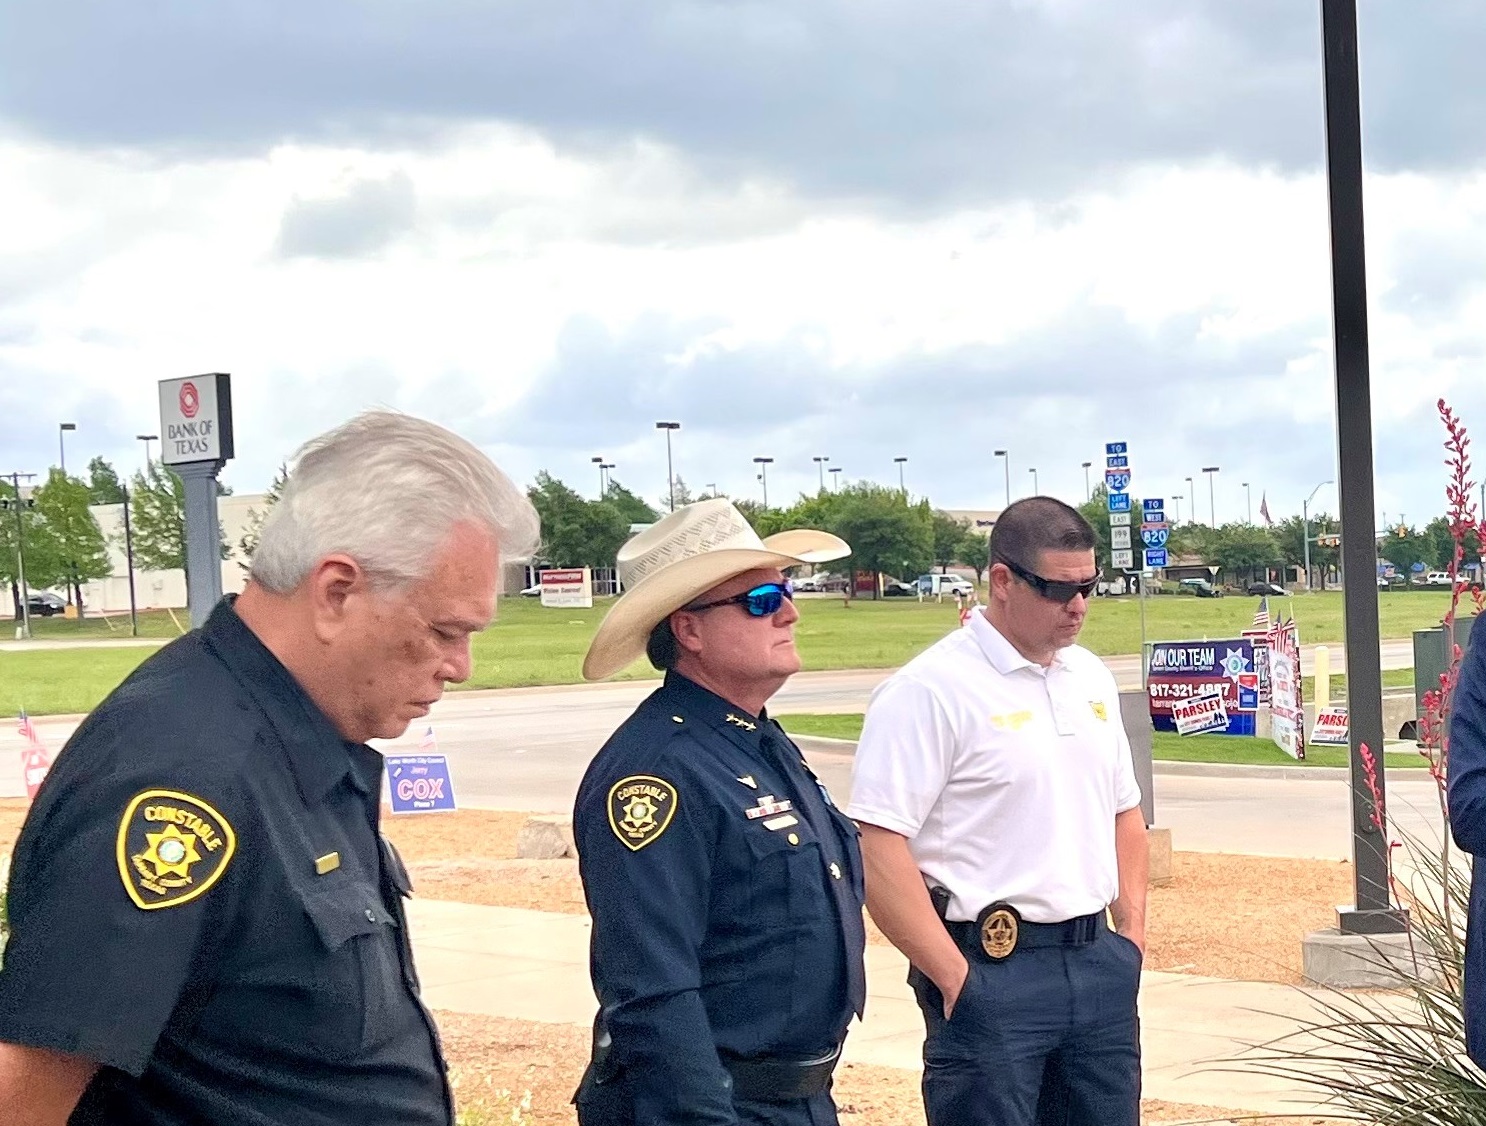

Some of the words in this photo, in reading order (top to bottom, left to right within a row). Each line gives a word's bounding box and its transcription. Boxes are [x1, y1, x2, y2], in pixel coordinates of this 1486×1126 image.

[168, 421, 198, 439] BANK
[200, 420, 213, 436] OF
[174, 438, 208, 455] TEXAS
[1111, 445, 1122, 453] TO
[1109, 457, 1126, 466] EAST
[1107, 474, 1129, 488] 820
[1111, 494, 1127, 502] LEFT
[1111, 501, 1127, 509] LANE
[1113, 515, 1127, 524] EAST
[1145, 513, 1162, 521] WEST
[1114, 529, 1127, 538] 199
[1144, 530, 1167, 543] 820
[1147, 550, 1165, 558] RIGHT
[1148, 557, 1164, 565] LANE
[1167, 648, 1187, 666] OUR
[1187, 648, 1215, 666] TEAM
[1175, 698, 1221, 720] PARSLEY
[397, 777, 445, 801] COX
[616, 784, 668, 802] CONSTABLE
[144, 805, 223, 852] CONSTABLE
